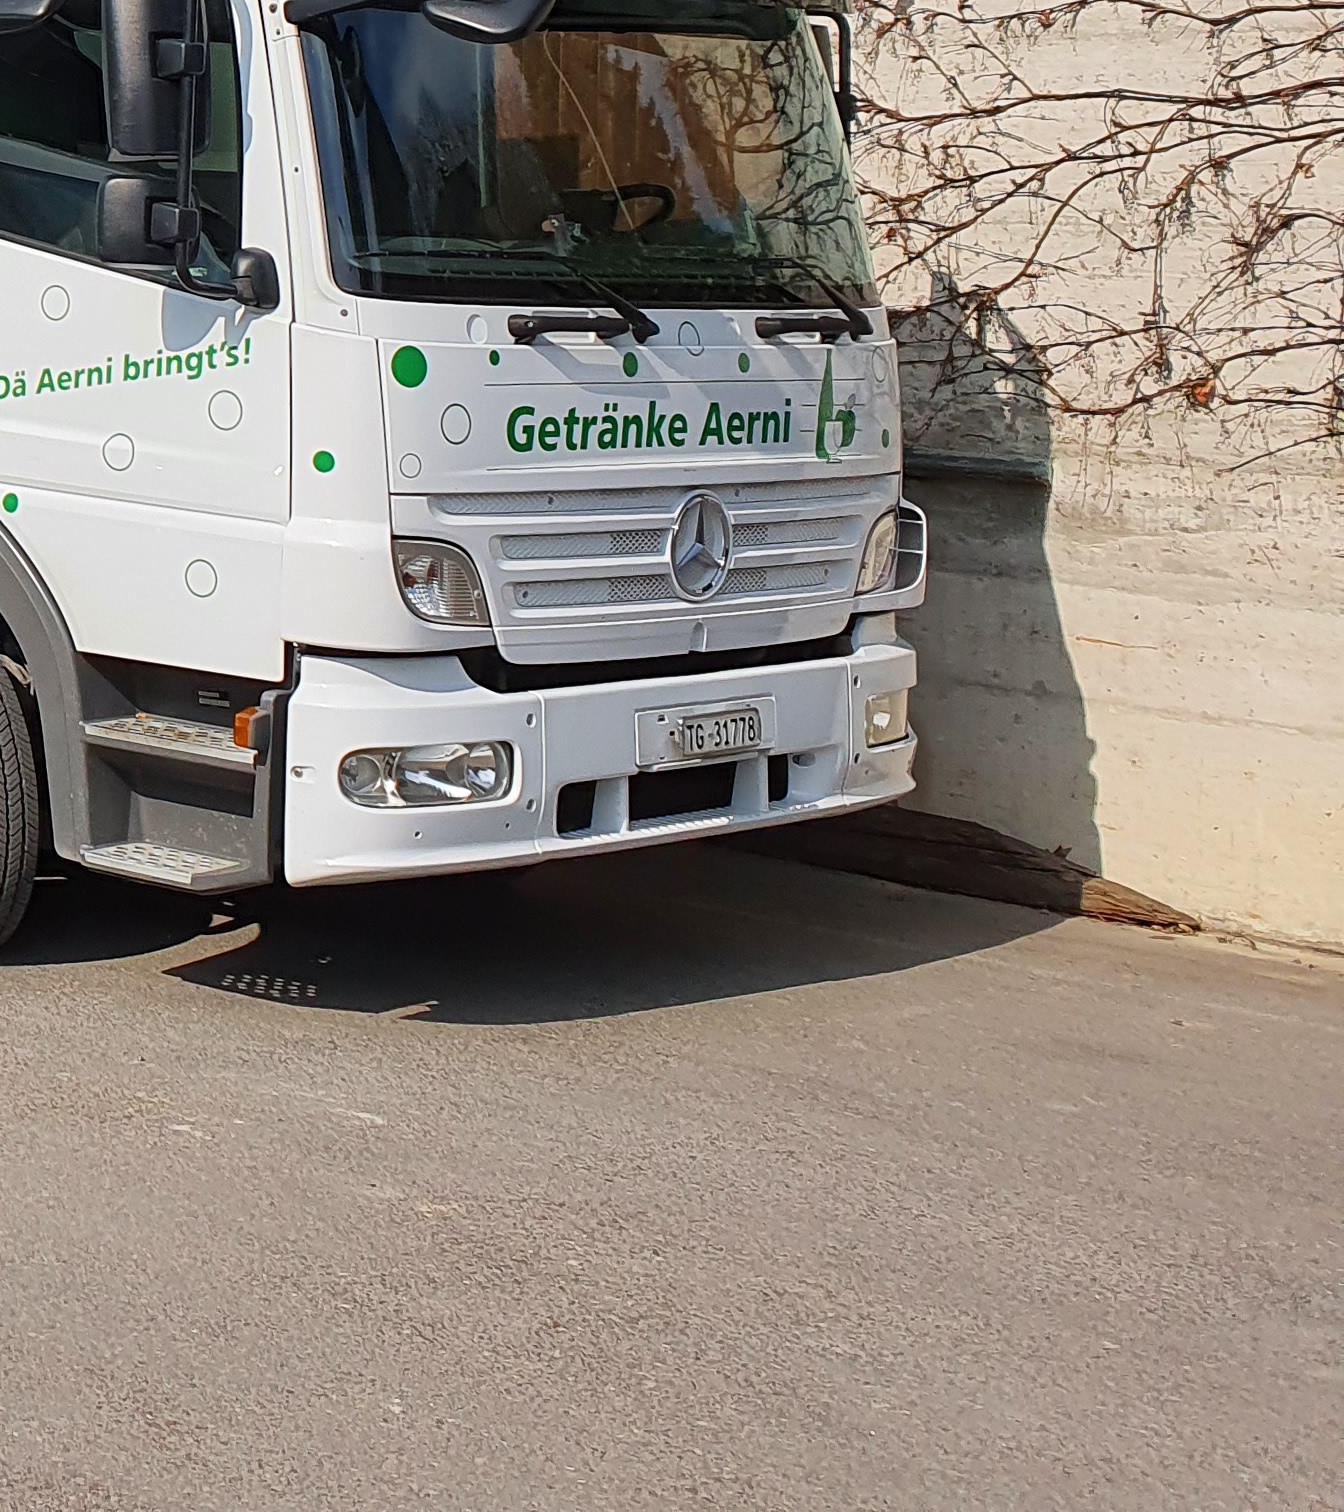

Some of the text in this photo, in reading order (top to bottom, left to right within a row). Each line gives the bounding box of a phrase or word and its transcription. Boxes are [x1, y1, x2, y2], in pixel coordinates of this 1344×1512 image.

[35, 357, 114, 395] Aerni
[506, 397, 792, 454] Getränke Aerni
